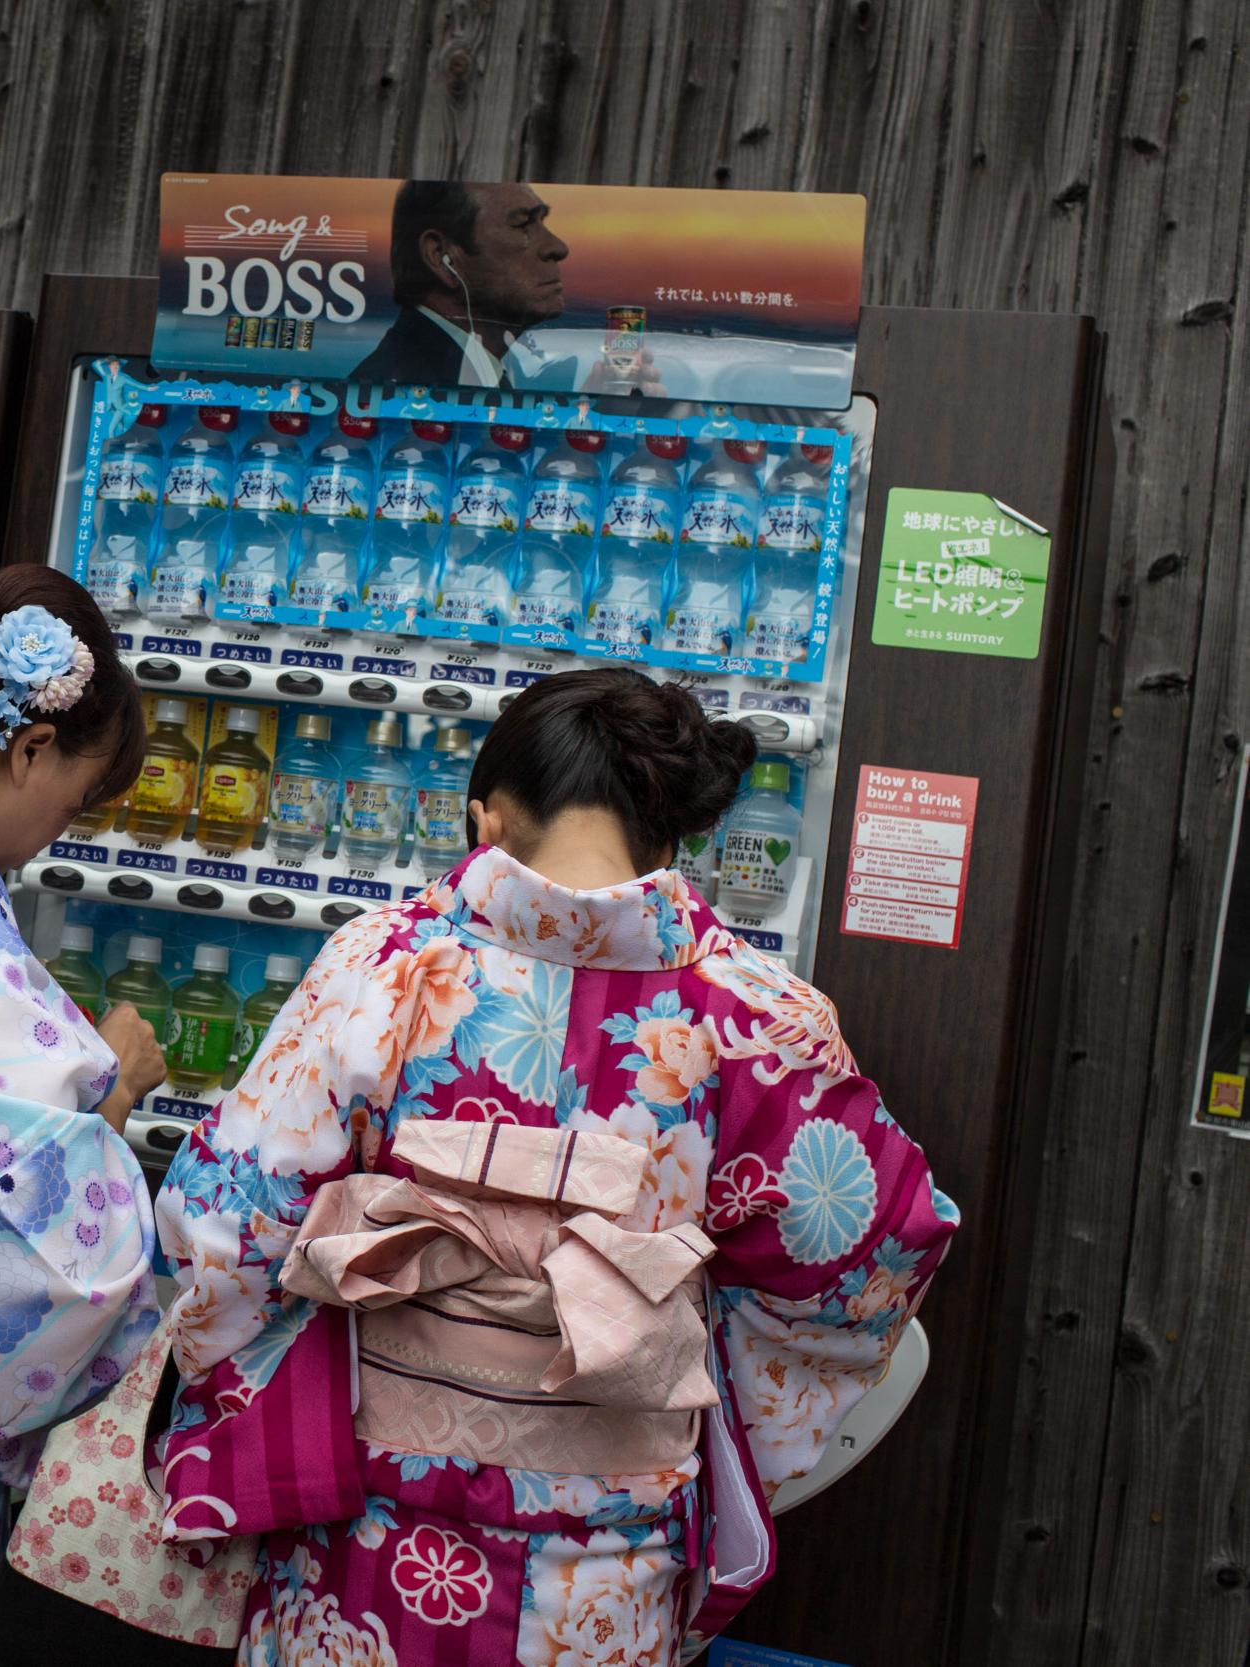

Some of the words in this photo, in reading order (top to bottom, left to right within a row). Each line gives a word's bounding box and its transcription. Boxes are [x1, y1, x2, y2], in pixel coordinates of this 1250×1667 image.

[218, 204, 308, 262] Song
[315, 214, 333, 236] &
[181, 255, 366, 324] BOSS
[654, 286, 798, 308] それでは、いい数分間を。
[99, 472, 144, 491] 天然水
[169, 476, 214, 497] 天然水
[238, 481, 285, 502] 天然水
[307, 487, 355, 507] 天然水
[382, 490, 432, 511] 天然水
[457, 495, 508, 519] 天然水
[531, 501, 582, 523] 天然水
[610, 506, 662, 529] 天然水
[688, 511, 741, 535] 天然水
[765, 517, 819, 541] 天然水
[893, 588, 1024, 619] ヒートポンプ
[164, 627, 188, 636] ¥120
[235, 633, 261, 642] ¥120
[946, 631, 1004, 646] SUNTORY
[148, 641, 197, 655] つめたい
[304, 640, 330, 649] ¥120
[374, 645, 401, 655] ¥120
[216, 646, 266, 662] つめたい
[287, 654, 338, 669] つめたい
[447, 653, 473, 666] ¥120
[358, 659, 415, 677] つめたい
[526, 661, 553, 671] ¥120
[433, 666, 490, 683] つめたい
[761, 683, 790, 692] ¥120
[746, 697, 804, 713] つめたい
[868, 770, 906, 789] How
[911, 776, 928, 790] to
[274, 790, 317, 803] ヨーグリーナ
[348, 797, 391, 810] ヨーグリーナ
[866, 785, 898, 802] buy
[902, 793, 914, 803] a
[917, 791, 962, 808] drink
[422, 807, 466, 818] ヨーグリーナ
[68, 833, 93, 842] ¥130
[726, 836, 763, 852] GREEN
[55, 846, 103, 861] つめたい
[137, 842, 163, 851] ¥130
[122, 854, 172, 870] つめたい
[206, 850, 231, 860] ¥130
[191, 863, 241, 879] つめたい
[276, 860, 303, 869] ¥130
[261, 872, 313, 888] つめたい
[348, 869, 375, 879] ¥130
[333, 882, 385, 897] つめたい
[733, 917, 762, 927] ¥130
[181, 1017, 199, 1065] 伊右衛門
[173, 1089, 200, 1099] ¥130
